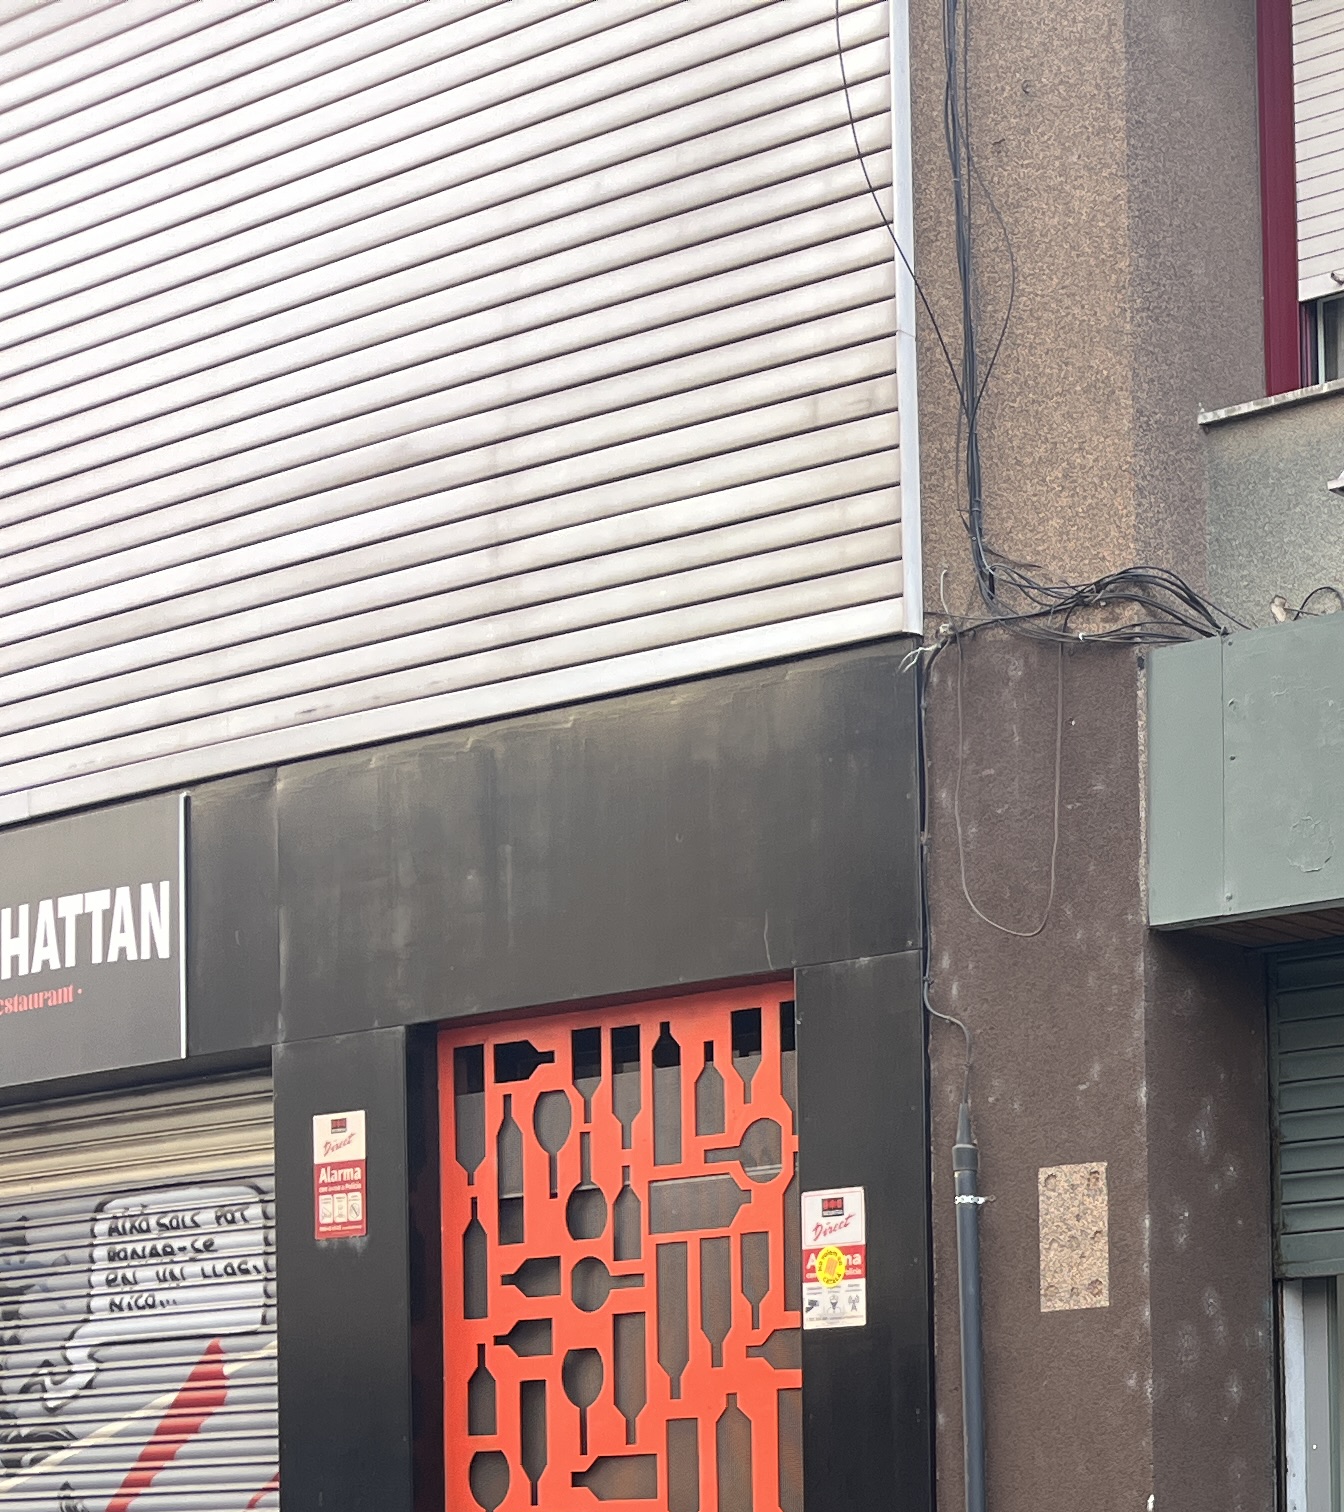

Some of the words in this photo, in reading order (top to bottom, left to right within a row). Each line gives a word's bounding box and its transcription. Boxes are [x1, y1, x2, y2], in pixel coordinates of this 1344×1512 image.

[0, 881, 170, 981] HATTAN
[318, 1166, 362, 1184] Alarma
[812, 1212, 857, 1241] Direct
